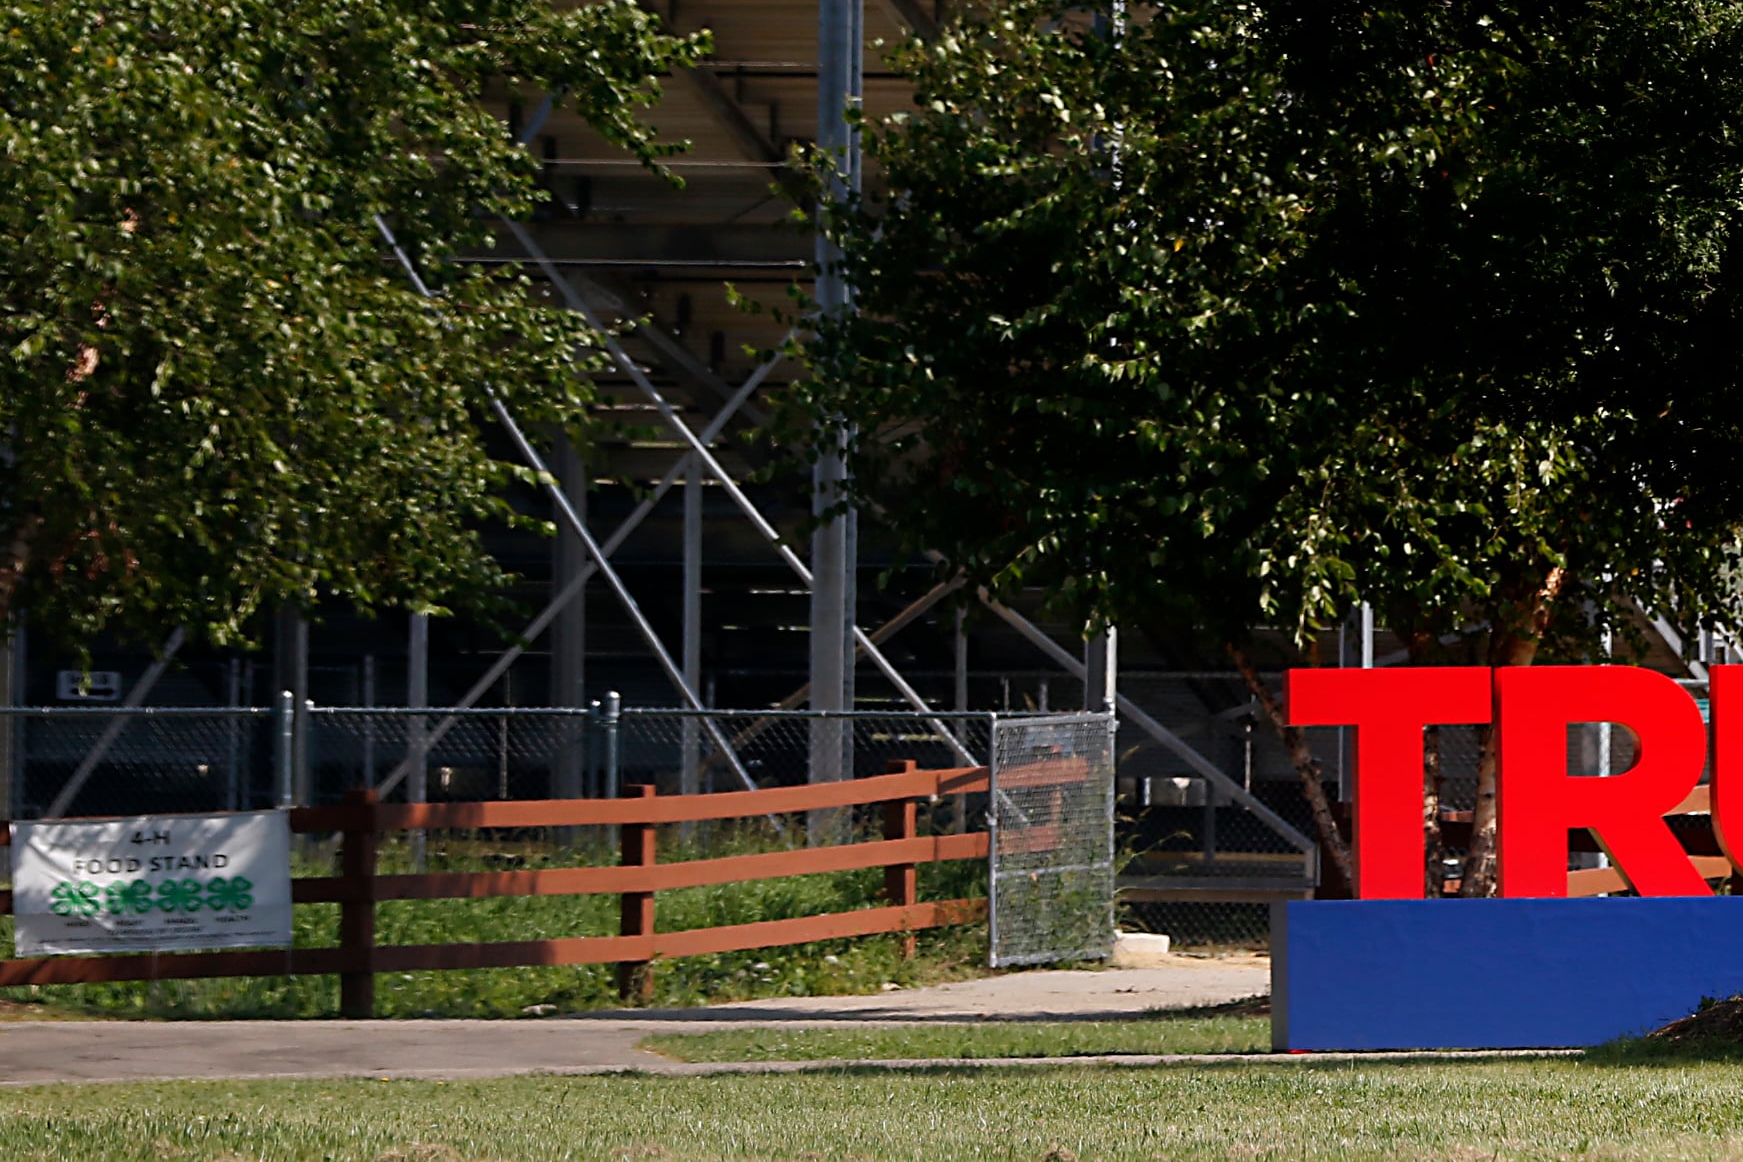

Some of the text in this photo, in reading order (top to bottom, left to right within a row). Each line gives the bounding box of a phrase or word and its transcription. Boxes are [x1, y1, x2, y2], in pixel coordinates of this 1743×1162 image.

[131, 831, 170, 846] 4-H
[73, 853, 230, 875] FOOD STAND
